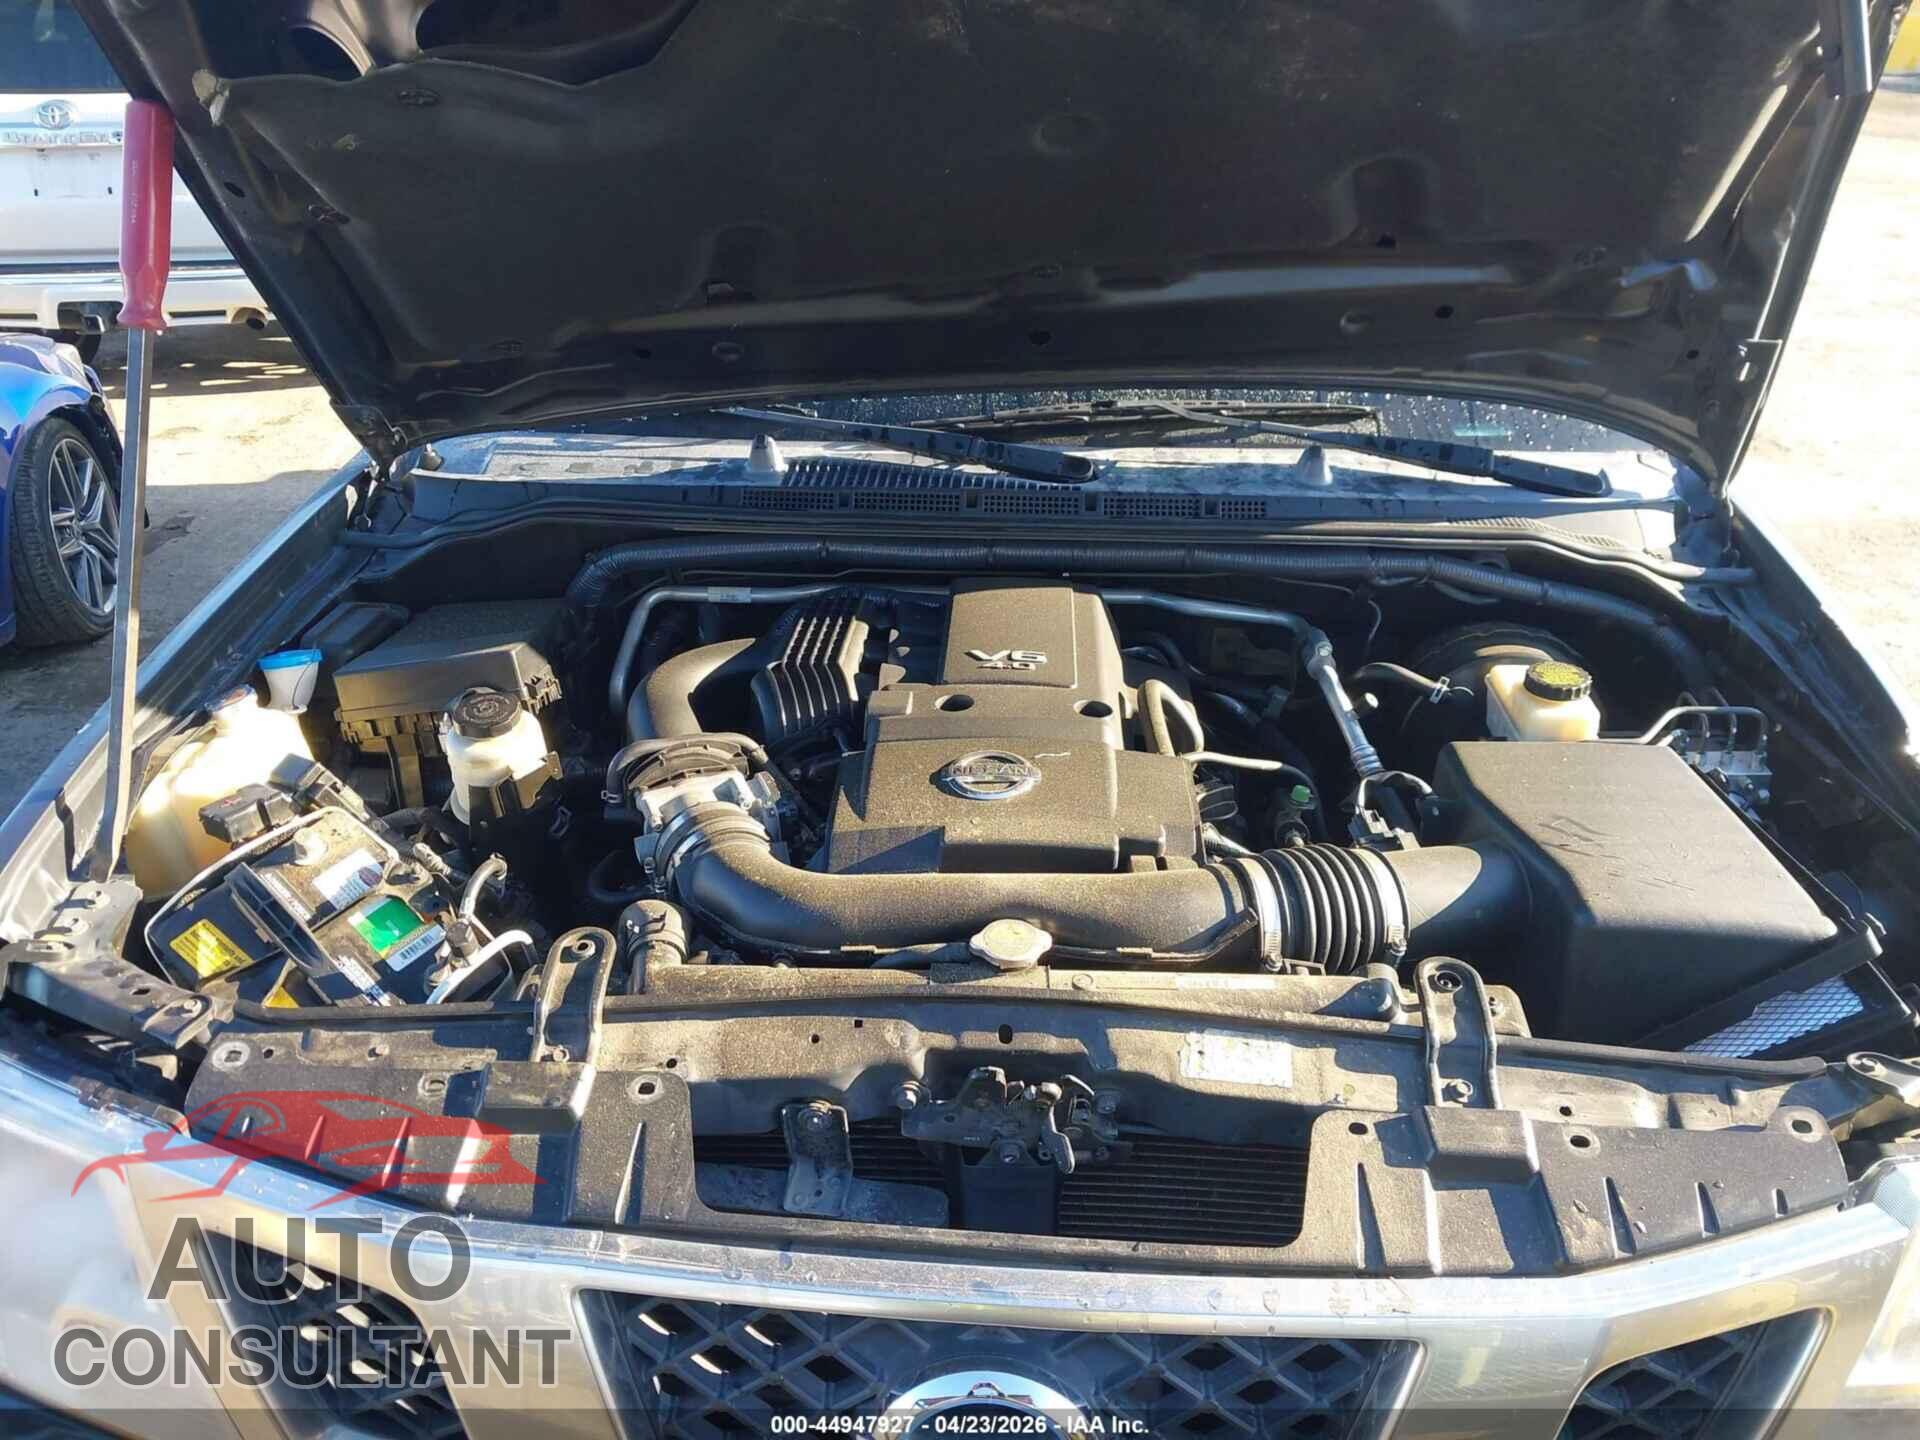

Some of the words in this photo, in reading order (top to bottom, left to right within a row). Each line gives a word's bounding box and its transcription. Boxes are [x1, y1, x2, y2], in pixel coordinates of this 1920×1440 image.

[965, 649, 1047, 664] V6
[978, 661, 1037, 671] 4.0
[951, 763, 1031, 777] NISSAN
